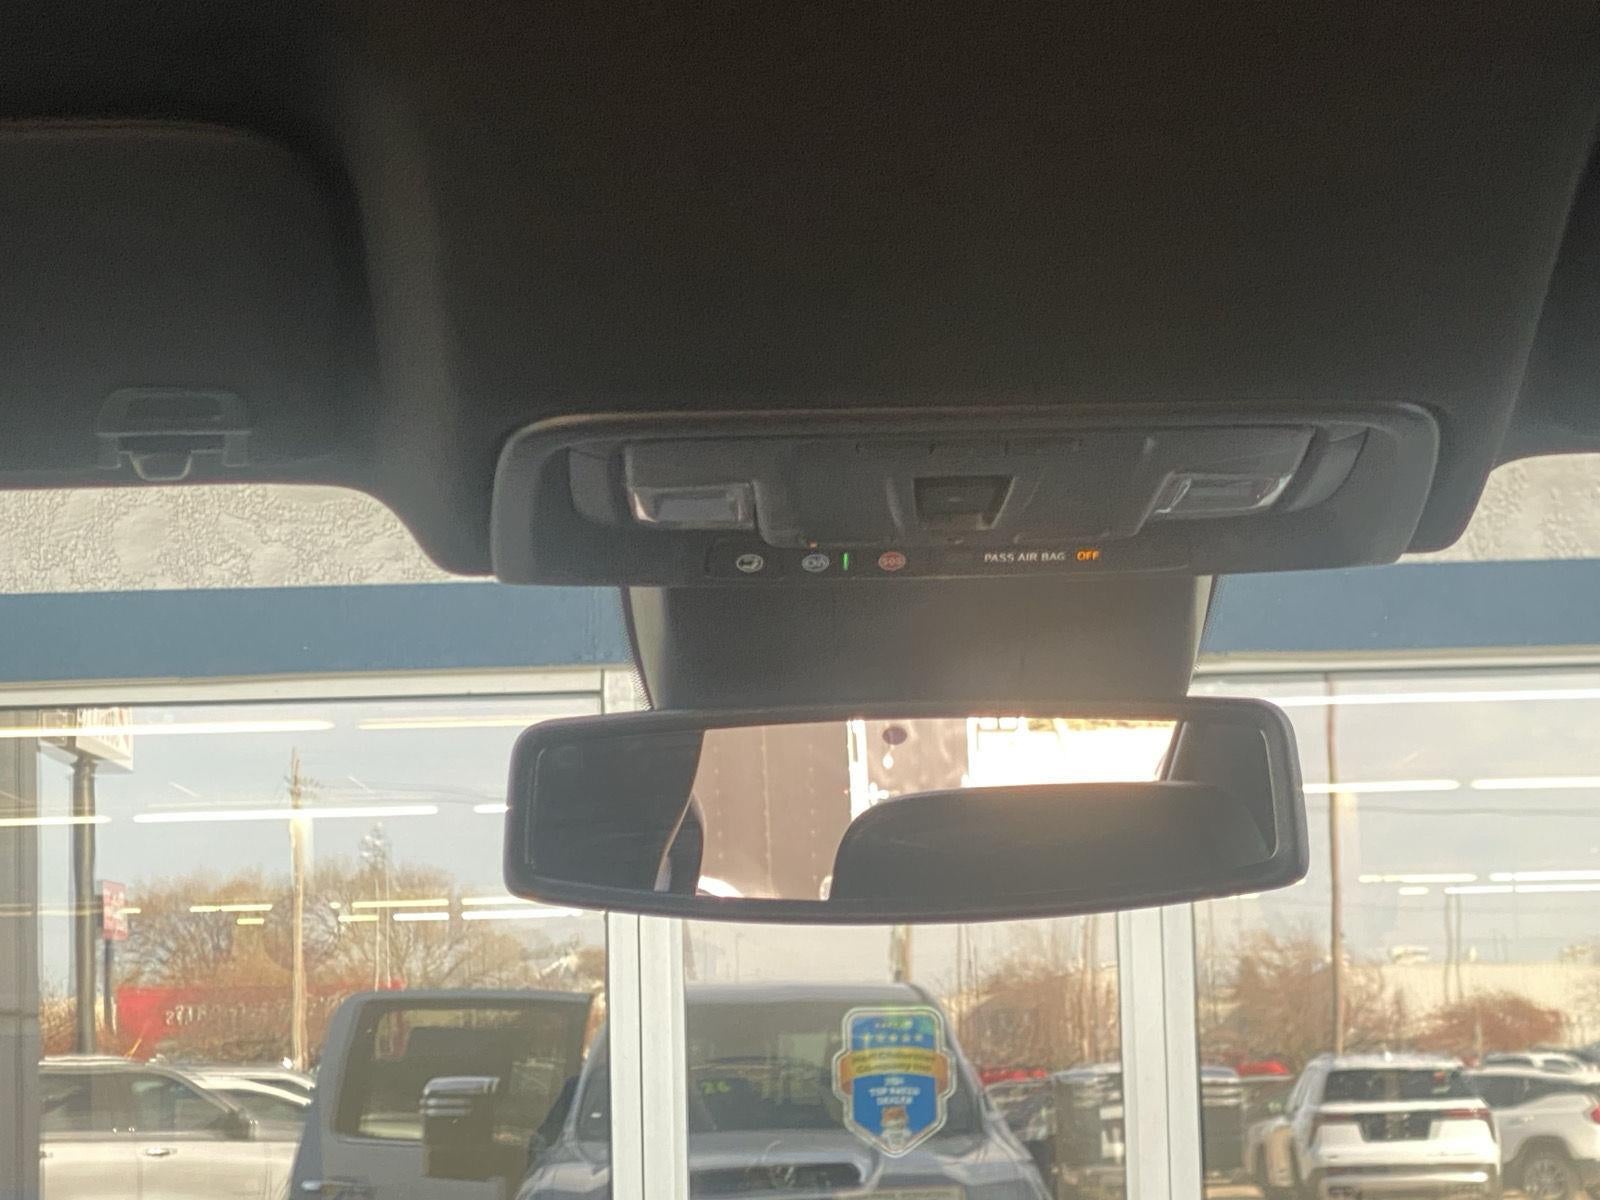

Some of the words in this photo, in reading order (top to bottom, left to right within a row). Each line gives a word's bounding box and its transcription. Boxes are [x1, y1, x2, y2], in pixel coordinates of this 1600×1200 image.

[881, 556, 902, 566] SOS
[984, 553, 1014, 562] PASS
[1017, 552, 1037, 561] AIR
[1041, 551, 1065, 560] BAG
[1077, 550, 1099, 560] OFF
